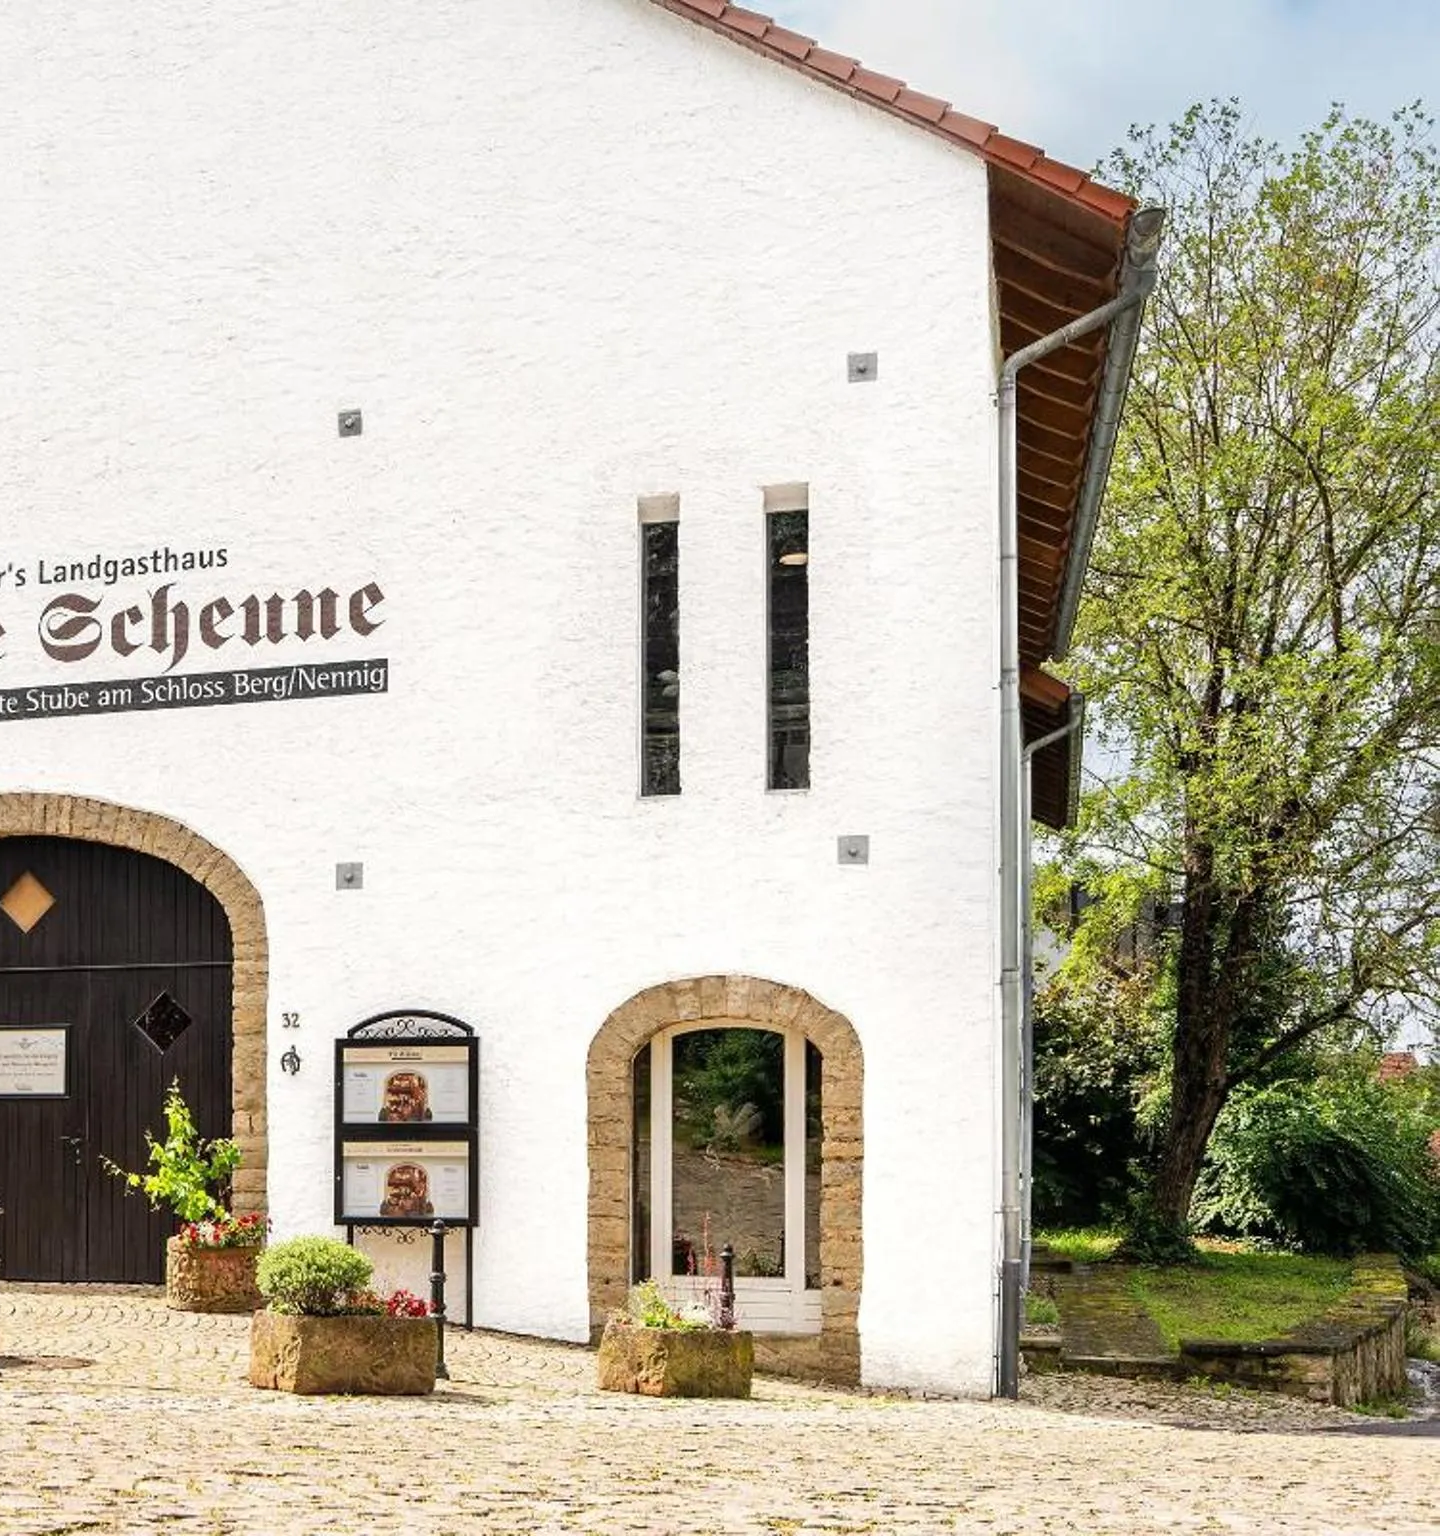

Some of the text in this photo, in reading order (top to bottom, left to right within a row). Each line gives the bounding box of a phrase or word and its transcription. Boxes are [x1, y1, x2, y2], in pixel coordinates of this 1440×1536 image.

[38, 546, 229, 586] Landgasthaus
[37, 581, 386, 674] Scheune
[26, 687, 91, 712] Stube
[97, 688, 132, 707] am
[141, 676, 225, 705] Schloss
[232, 662, 386, 702] Berg/Nennig
[281, 1012, 301, 1029] 32
